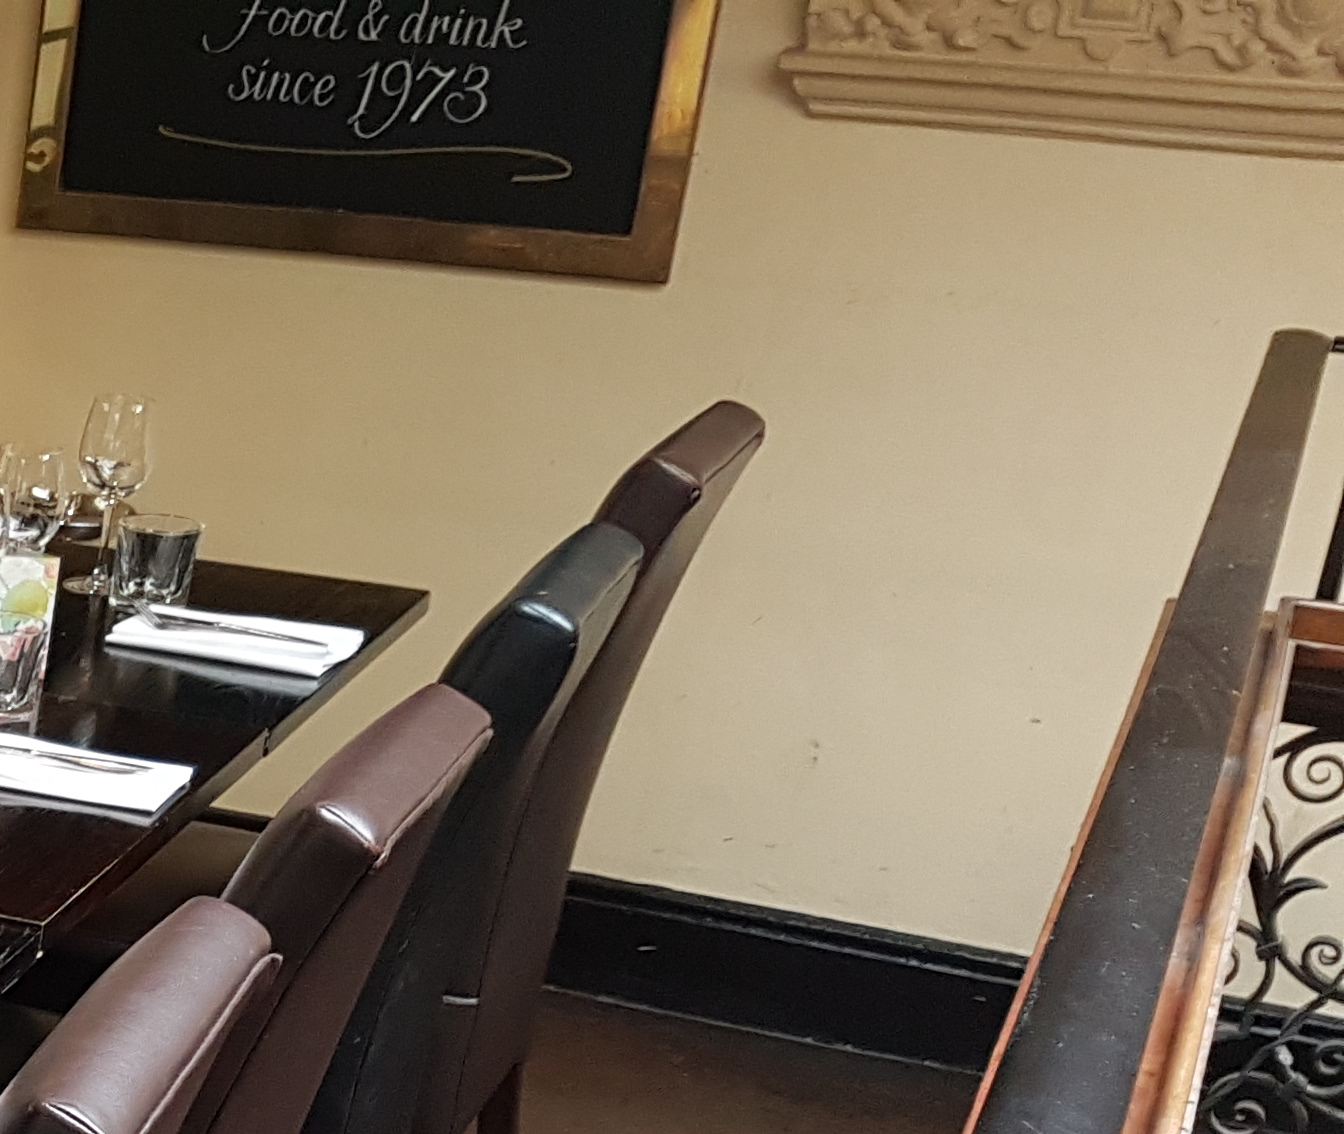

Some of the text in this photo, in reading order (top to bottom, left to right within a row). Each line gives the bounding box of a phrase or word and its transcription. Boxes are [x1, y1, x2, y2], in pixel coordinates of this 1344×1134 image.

[201, 0, 528, 53] food & drink
[227, 57, 490, 140] since 1973
